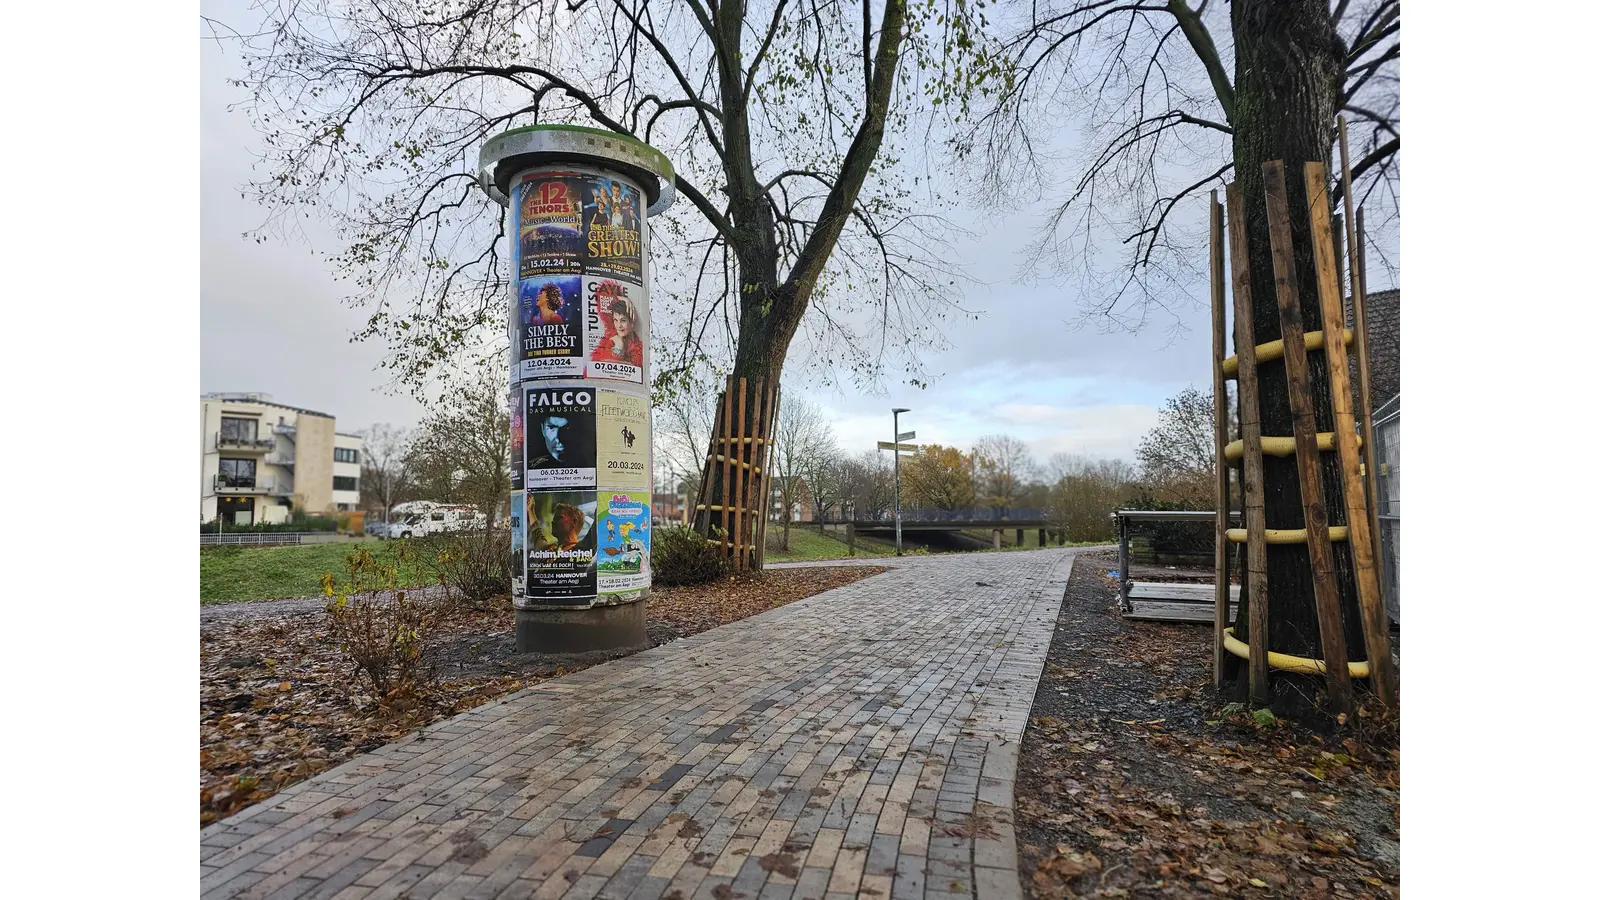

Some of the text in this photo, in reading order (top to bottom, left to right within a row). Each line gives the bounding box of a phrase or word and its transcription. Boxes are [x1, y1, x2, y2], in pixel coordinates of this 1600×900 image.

[539, 182, 568, 205] 12
[529, 204, 570, 215] TENORS
[588, 230, 639, 241] GREATEST
[588, 240, 640, 258] SHOW!
[530, 259, 564, 268] 15.02.24
[586, 265, 611, 273] HANNOVER
[614, 269, 630, 277] THEATER
[588, 294, 599, 332] TUFTS
[528, 324, 569, 338] SIMPLY
[524, 337, 544, 350] THE
[546, 336, 576, 348] BEST
[528, 358, 571, 368] 12.04.2024
[595, 362, 636, 374] 07.04.2024
[530, 392, 592, 407] FALCO
[608, 460, 644, 470] 20.03.2024
[540, 468, 578, 476] 06.03.2024
[530, 548, 592, 558] Achim Reichel
